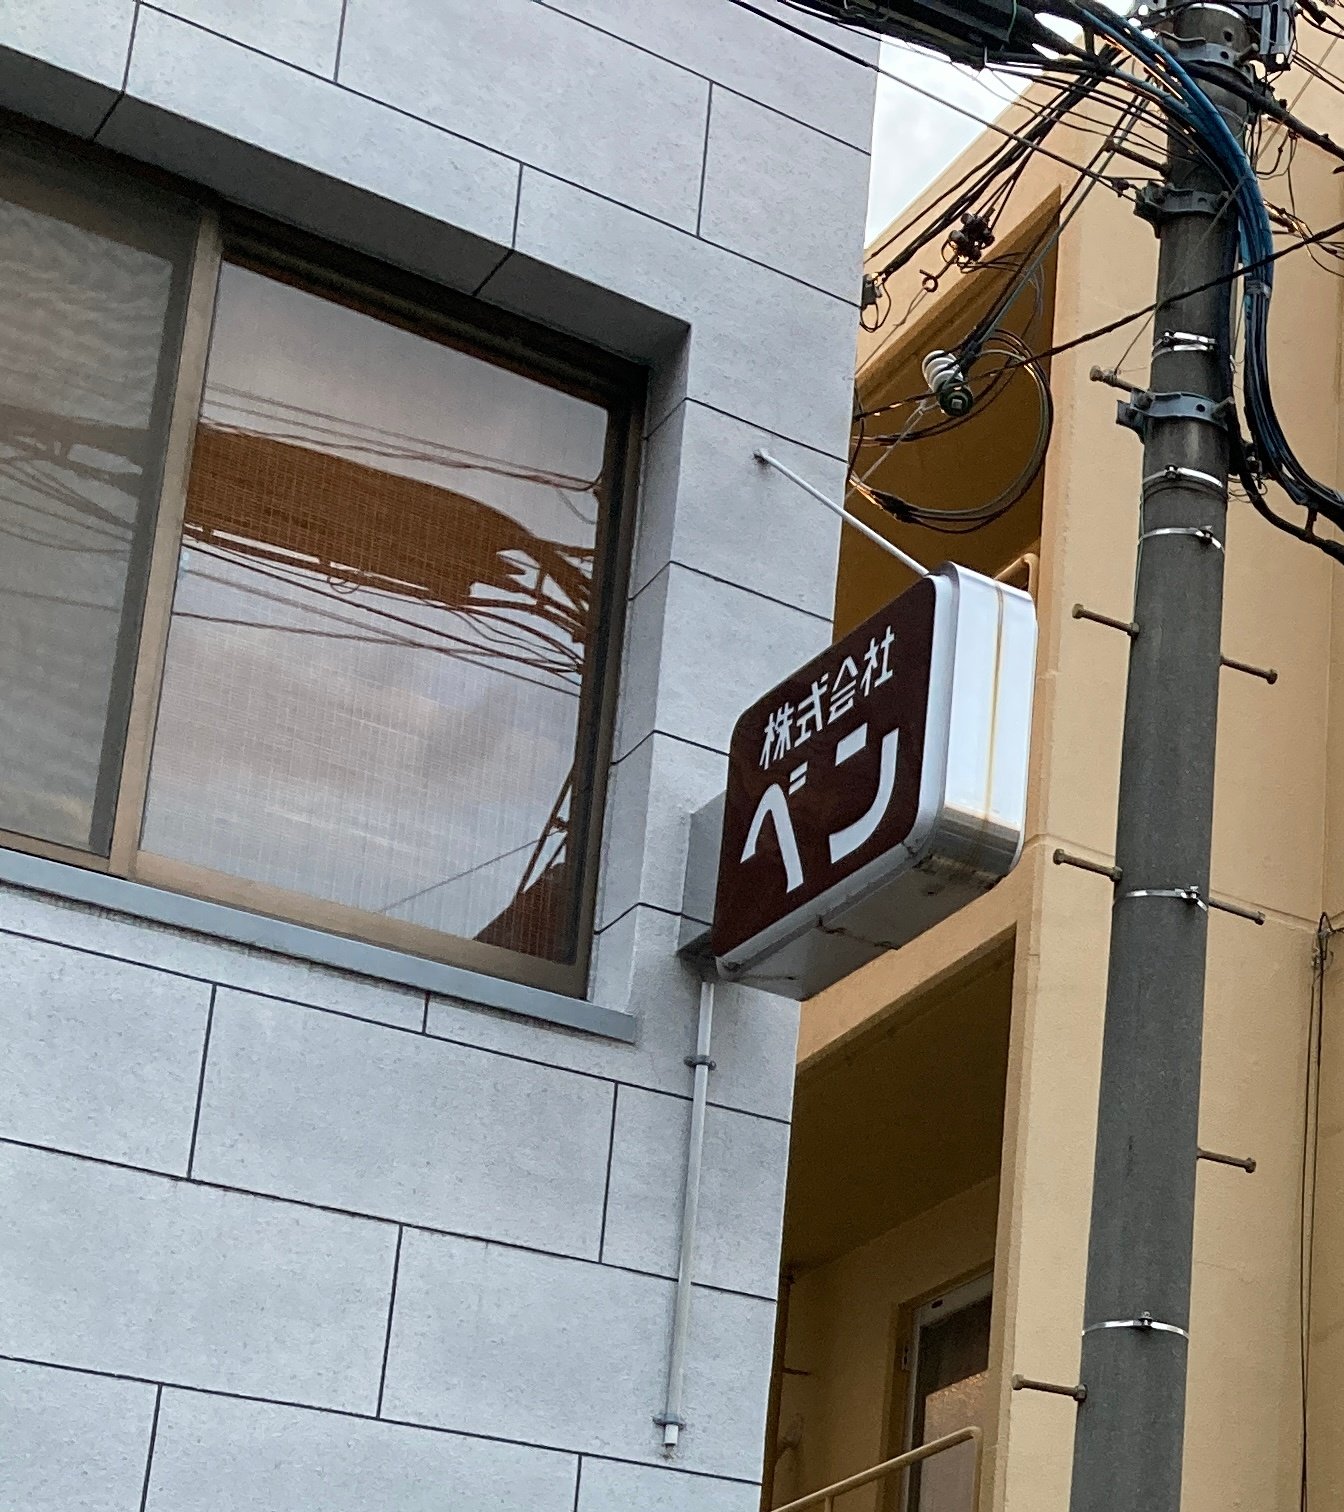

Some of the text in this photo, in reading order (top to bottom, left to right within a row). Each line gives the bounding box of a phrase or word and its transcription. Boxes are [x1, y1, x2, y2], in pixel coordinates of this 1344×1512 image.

[759, 625, 896, 771] 株式会社
[739, 722, 899, 894] ベン
